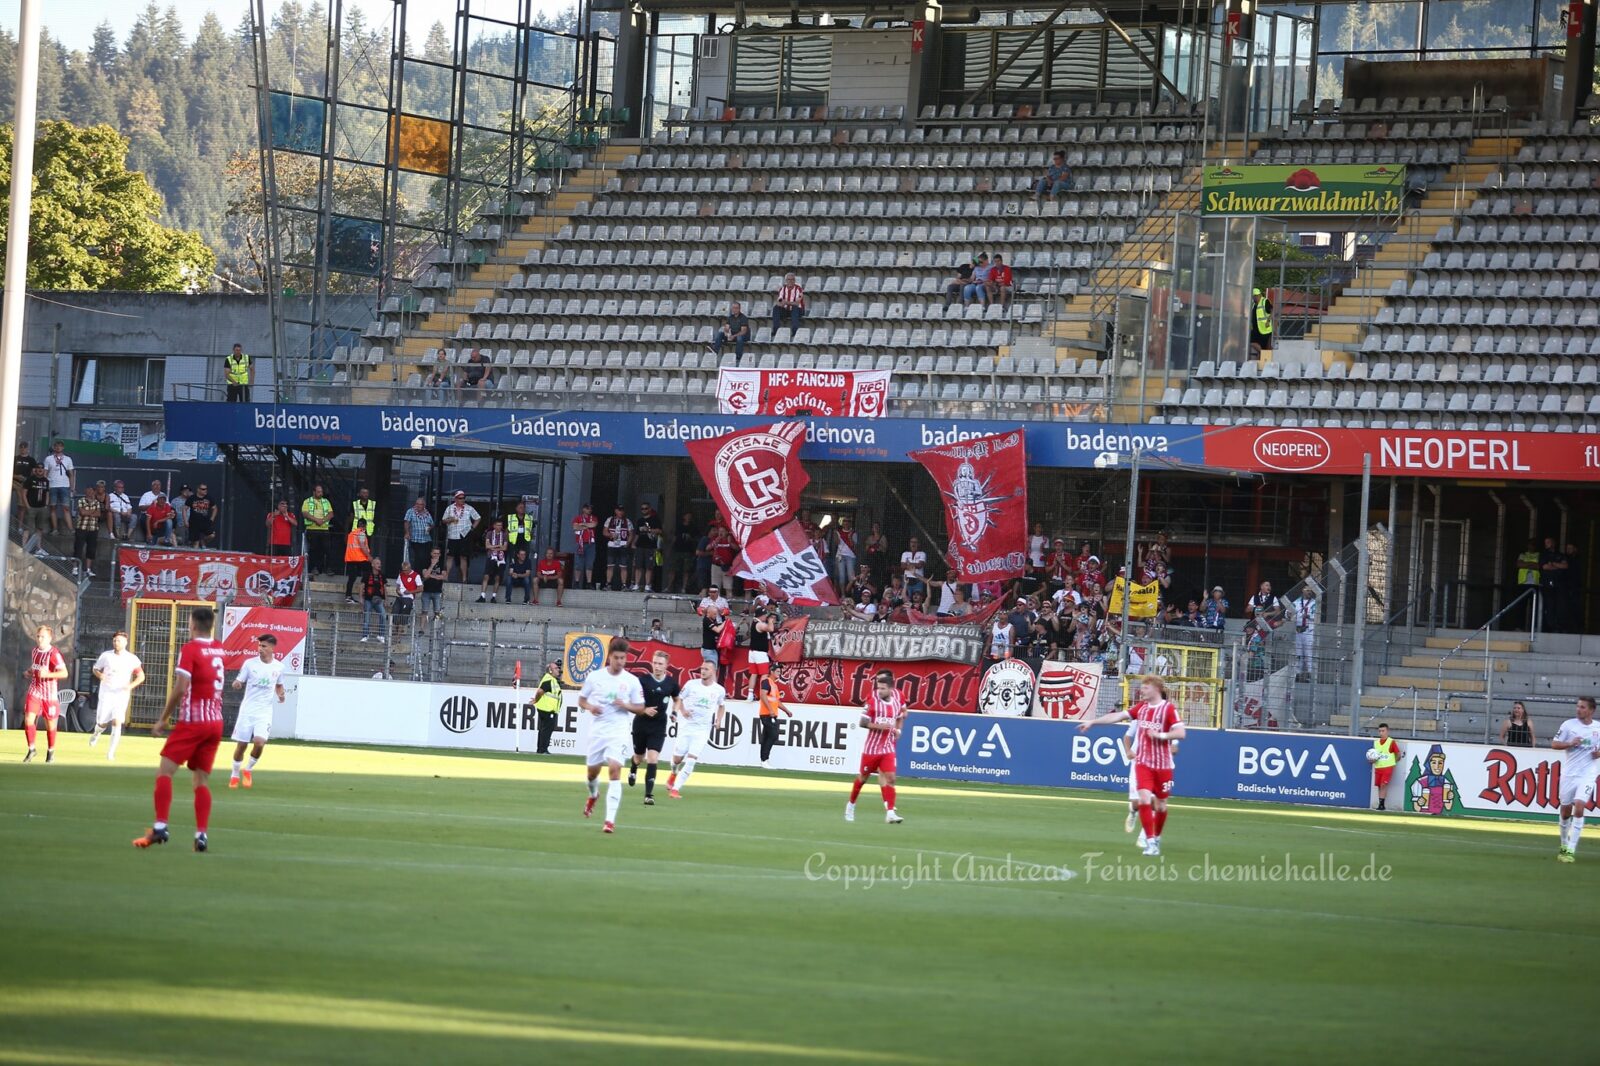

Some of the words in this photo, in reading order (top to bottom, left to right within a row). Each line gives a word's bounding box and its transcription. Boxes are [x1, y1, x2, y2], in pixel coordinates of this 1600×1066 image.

[1228, 21, 1239, 35] K
[1570, 12, 1579, 25] L
[913, 29, 923, 42] K
[1206, 191, 1399, 212] Schwarzwaldmilch
[768, 372, 790, 387] HFC
[796, 373, 846, 388] FANCLUB
[859, 380, 884, 393] HFC
[255, 408, 340, 431] badenova
[380, 411, 469, 433] badenova
[511, 414, 601, 438] badenova
[643, 418, 735, 441] badenova
[805, 421, 875, 444] denova
[1066, 428, 1168, 452] badenova
[718, 437, 782, 468] SURREALE
[1380, 437, 1530, 471] NEOPERL
[212, 656, 224, 691] 3
[440, 696, 479, 734] AHP
[486, 701, 578, 733] MERLE
[911, 725, 977, 756] BGV
[809, 754, 846, 766] BEWEGT
[910, 760, 947, 772] Badische
[948, 763, 1011, 777] Versicherungen
[1238, 746, 1309, 778] BGV
[1070, 771, 1108, 783] Badische
[1237, 782, 1277, 794] Badische
[1278, 785, 1346, 800] Versicherungen
